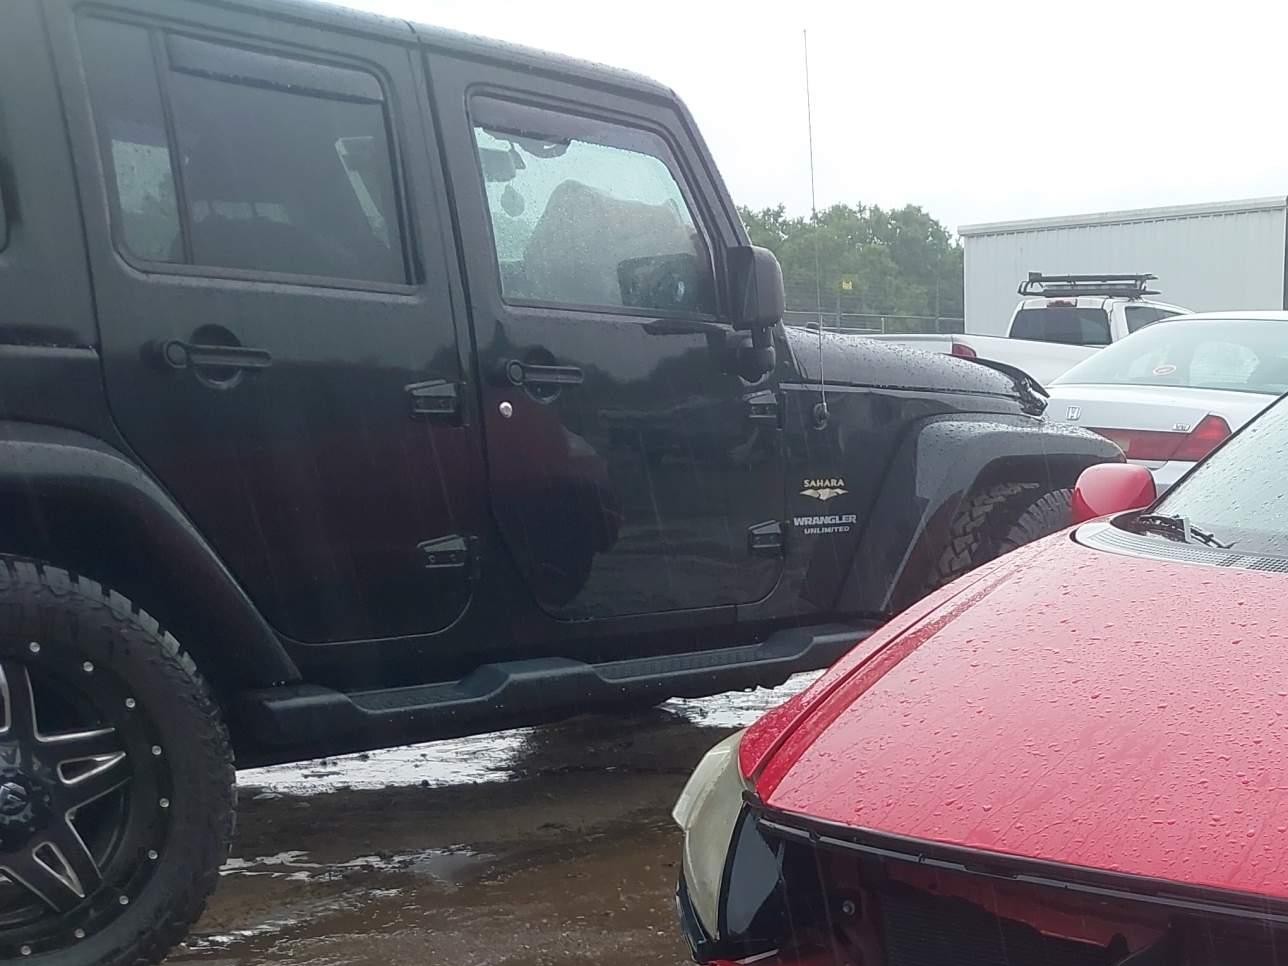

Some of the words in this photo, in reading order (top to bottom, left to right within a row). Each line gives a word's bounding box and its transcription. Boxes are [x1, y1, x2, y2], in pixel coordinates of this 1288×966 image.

[803, 478, 845, 488] SAHARA
[793, 514, 857, 526] WRANGLER
[803, 525, 850, 535] UNLIMITED
